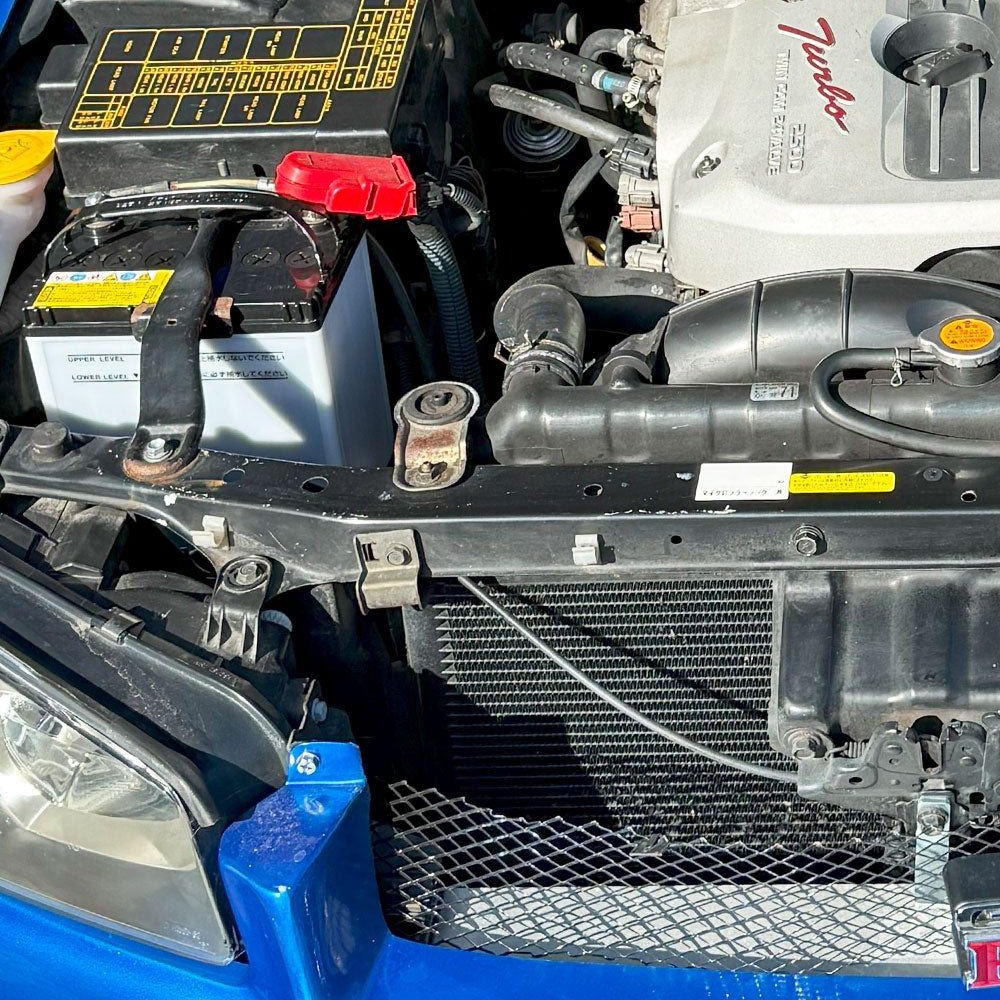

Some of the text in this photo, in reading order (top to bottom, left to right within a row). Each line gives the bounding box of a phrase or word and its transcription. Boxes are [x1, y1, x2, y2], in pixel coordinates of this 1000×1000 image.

[772, 83, 789, 113] CAM
[777, 16, 857, 136] Turbo
[786, 123, 807, 174] 2500
